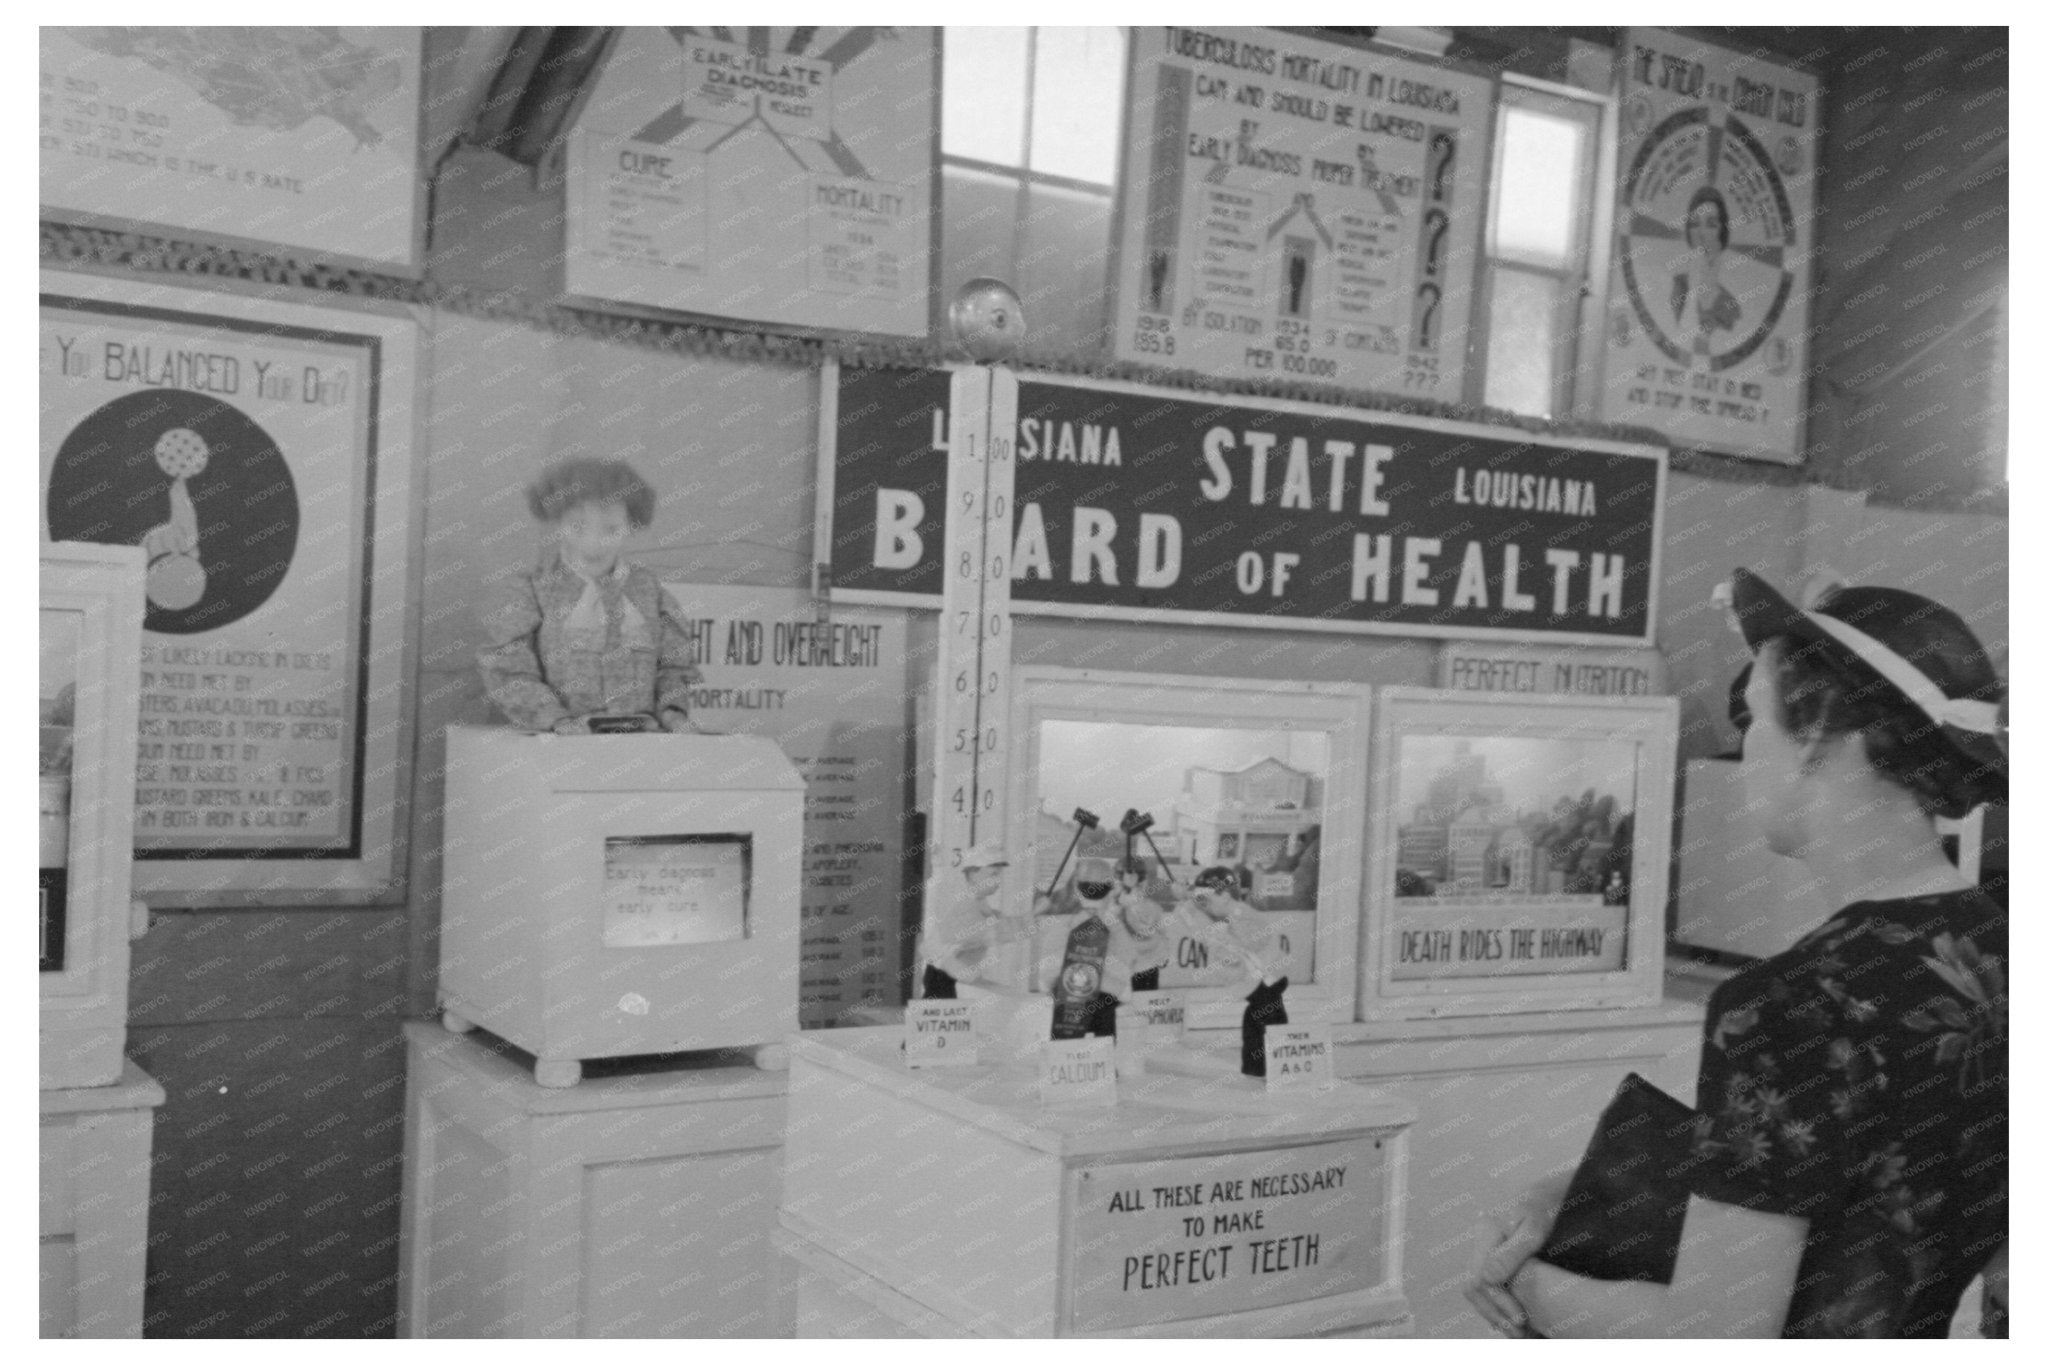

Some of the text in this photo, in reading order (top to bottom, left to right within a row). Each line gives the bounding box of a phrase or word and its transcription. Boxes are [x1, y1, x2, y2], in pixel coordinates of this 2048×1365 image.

[707, 67, 809, 99] DIAGNOSIS
[1165, 27, 1460, 116] TUBERCULOSIS MORTALITY IN LOUISIANA
[1196, 74, 1425, 143] CAN AND SHOULD BE LOWERED
[816, 184, 904, 216] MORTALITY
[104, 341, 240, 395] BALANCED
[1245, 347, 1275, 369] PER
[1200, 425, 1395, 517] STATE
[1455, 466, 1596, 517] LOUISIANA
[873, 486, 1625, 618] BARD OF HEALTH
[725, 619, 764, 667] AND
[773, 620, 882, 667] OVERWEIGHT
[161, 672, 252, 692] NEED MET BY
[1452, 657, 1649, 697] PERFECT NUTRITION
[169, 743, 205, 761] NEED
[210, 743, 235, 761] MET
[241, 744, 259, 762] BY
[162, 810, 198, 829] BOTH
[255, 811, 308, 829] CALCIUM
[1177, 936, 1210, 969] CAN
[1401, 926, 1607, 964] DEATH RIDES THE HIGHWAY
[915, 1019, 972, 1033] VITAMIN
[922, 1008, 942, 1018] AND
[936, 1035, 947, 1049] D
[1273, 1042, 1326, 1059] VITAMINS
[1050, 1061, 1106, 1085] CALCIUM
[1280, 1062, 1290, 1075] A
[1108, 1166, 1347, 1214] ALL THESE ARE NECESSARY
[1183, 1209, 1265, 1239] TO MAKE
[1123, 1232, 1320, 1293] PERFECT TEETH
